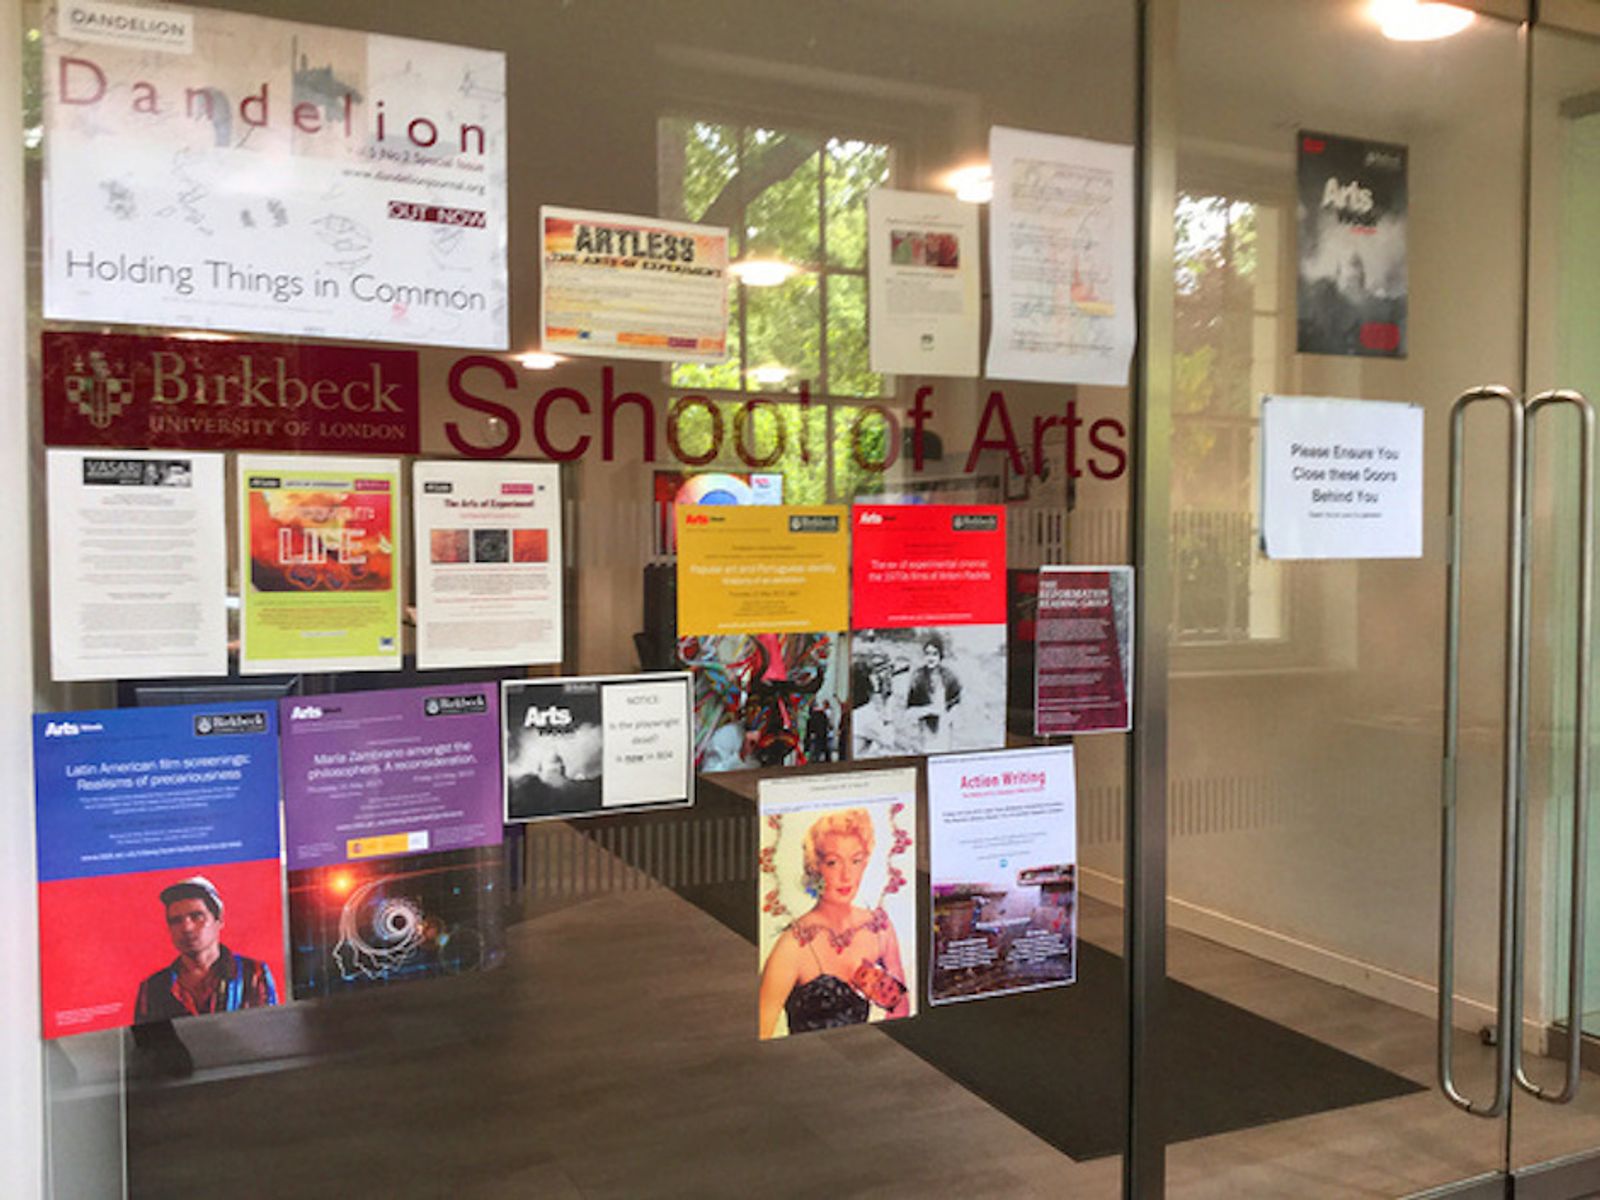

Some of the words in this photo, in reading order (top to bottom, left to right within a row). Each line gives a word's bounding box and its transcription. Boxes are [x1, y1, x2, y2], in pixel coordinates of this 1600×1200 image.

[70, 8, 186, 37] DANDELION
[58, 56, 487, 156] Dandelion
[414, 151, 452, 167] Special
[1321, 176, 1374, 214] Arts
[389, 201, 426, 220] OUT
[437, 207, 487, 228] NOW
[575, 224, 695, 262] ARTLESS
[65, 250, 195, 296] Holding
[203, 259, 304, 303] Things
[314, 270, 340, 298] in
[350, 273, 487, 311] Common
[150, 350, 405, 413] Birkbeck
[444, 355, 811, 468] School
[851, 385, 935, 473] of
[965, 391, 1128, 480] Arts
[148, 415, 278, 437] UNIVERSITY
[284, 420, 310, 437] OF
[320, 422, 406, 439] LONDON
[1290, 443, 1330, 459] Please
[1333, 445, 1373, 460] Ensure
[1377, 446, 1400, 460] You
[1291, 466, 1326, 481] Close
[1329, 468, 1360, 482] these
[1364, 467, 1398, 482] Doors
[444, 498, 459, 508] The
[461, 498, 478, 508] Arts
[491, 498, 534, 509] Experiment
[1311, 488, 1352, 503] Behind
[1357, 490, 1379, 503] You
[685, 514, 709, 525] Arts
[859, 512, 883, 525] Arts
[279, 527, 367, 564] LIFE
[440, 696, 485, 709] Birkbeck
[626, 695, 659, 705] NOTICE
[213, 714, 263, 728] Birkbeck
[291, 705, 323, 720] Arts
[524, 705, 573, 727] Arts
[45, 722, 80, 737] Arts
[406, 743, 452, 758] amongst
[453, 742, 472, 753] the
[65, 764, 98, 778] Latin
[99, 760, 156, 775] American
[159, 758, 181, 770] film
[384, 762, 393, 772] A
[76, 777, 133, 791] Realisms
[136, 776, 148, 788] of
[149, 770, 242, 788] precariousness
[960, 774, 1000, 789] Action
[1002, 770, 1046, 787] Writing
